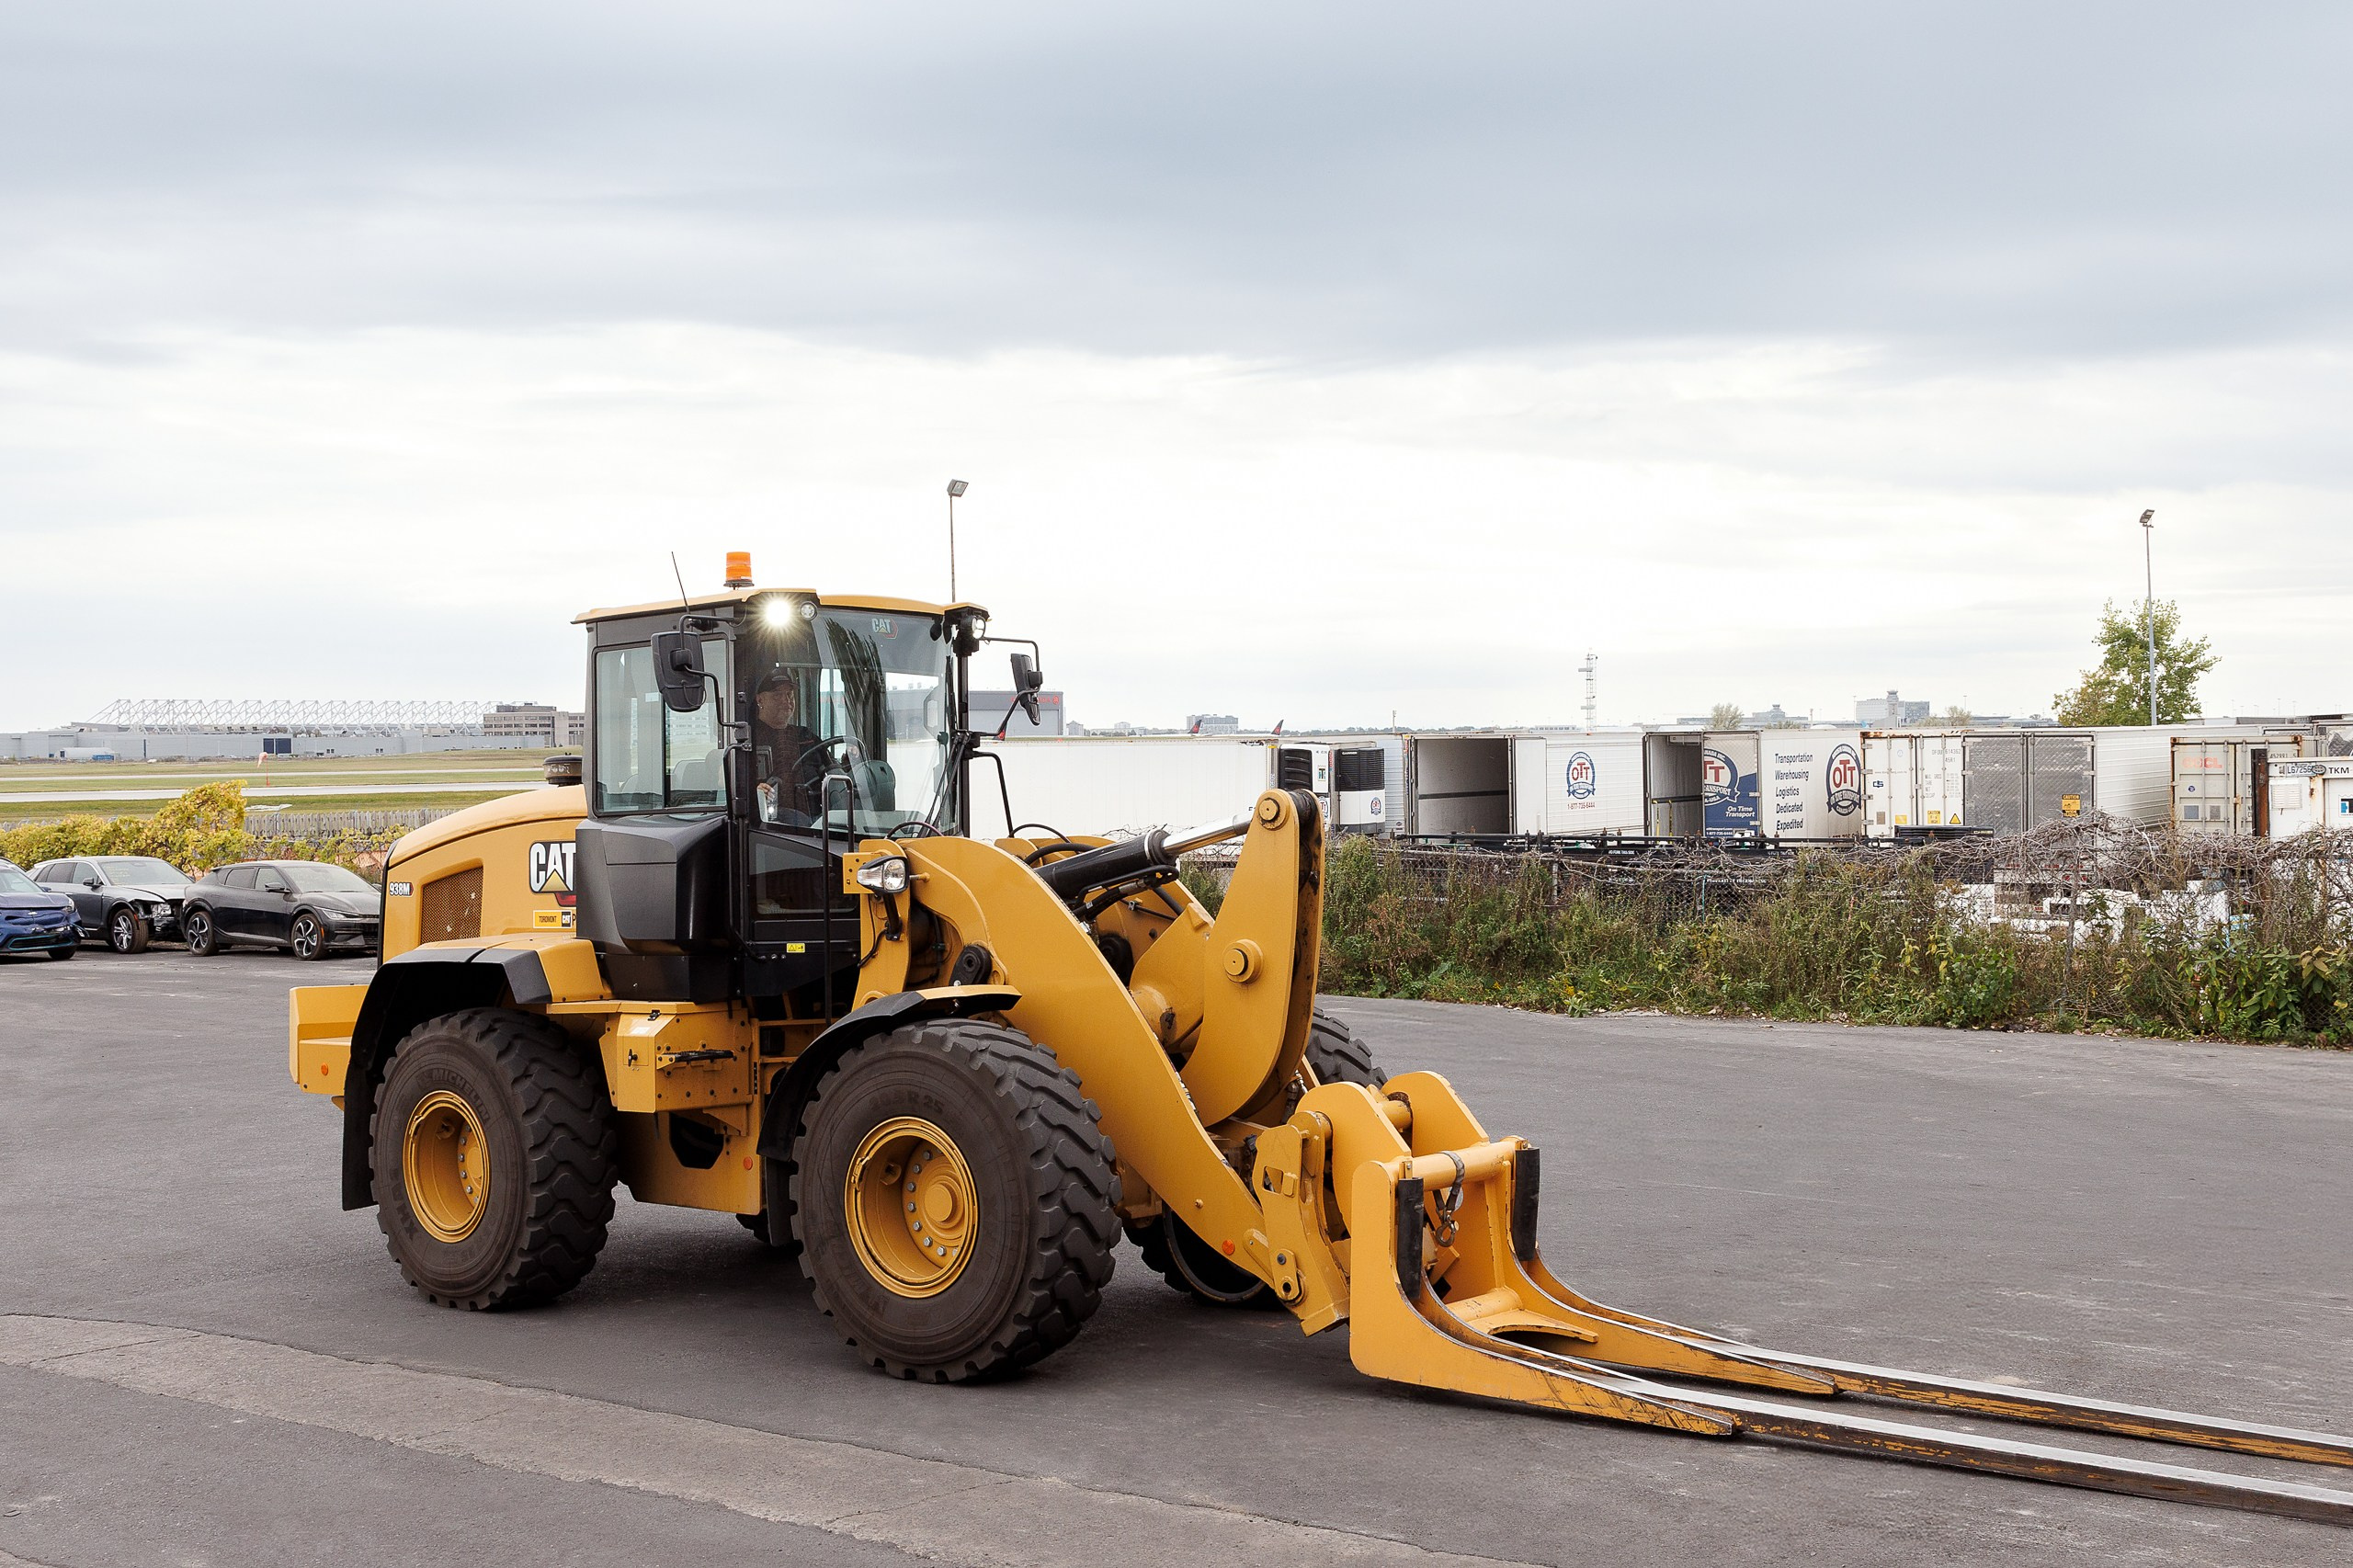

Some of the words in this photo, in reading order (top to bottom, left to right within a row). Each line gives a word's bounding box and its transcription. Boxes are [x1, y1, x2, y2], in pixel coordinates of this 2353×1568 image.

[872, 618, 891, 633] CAT
[1775, 752, 1813, 766] Transportation
[1572, 762, 1590, 780] OTT
[1704, 761, 1724, 782] TT
[1775, 769, 1809, 781] Warehousing
[1833, 759, 1856, 788] OTT
[2288, 766, 2313, 774] L67256
[1704, 785, 1732, 796] ANSPORT
[1776, 786, 1800, 799] Logistics
[1776, 801, 1803, 813] Dedicated
[1777, 818, 1803, 832] Expedited
[530, 843, 576, 892] CAT
[390, 882, 411, 896] 938M
[432, 1068, 491, 1123] MICHELIN
